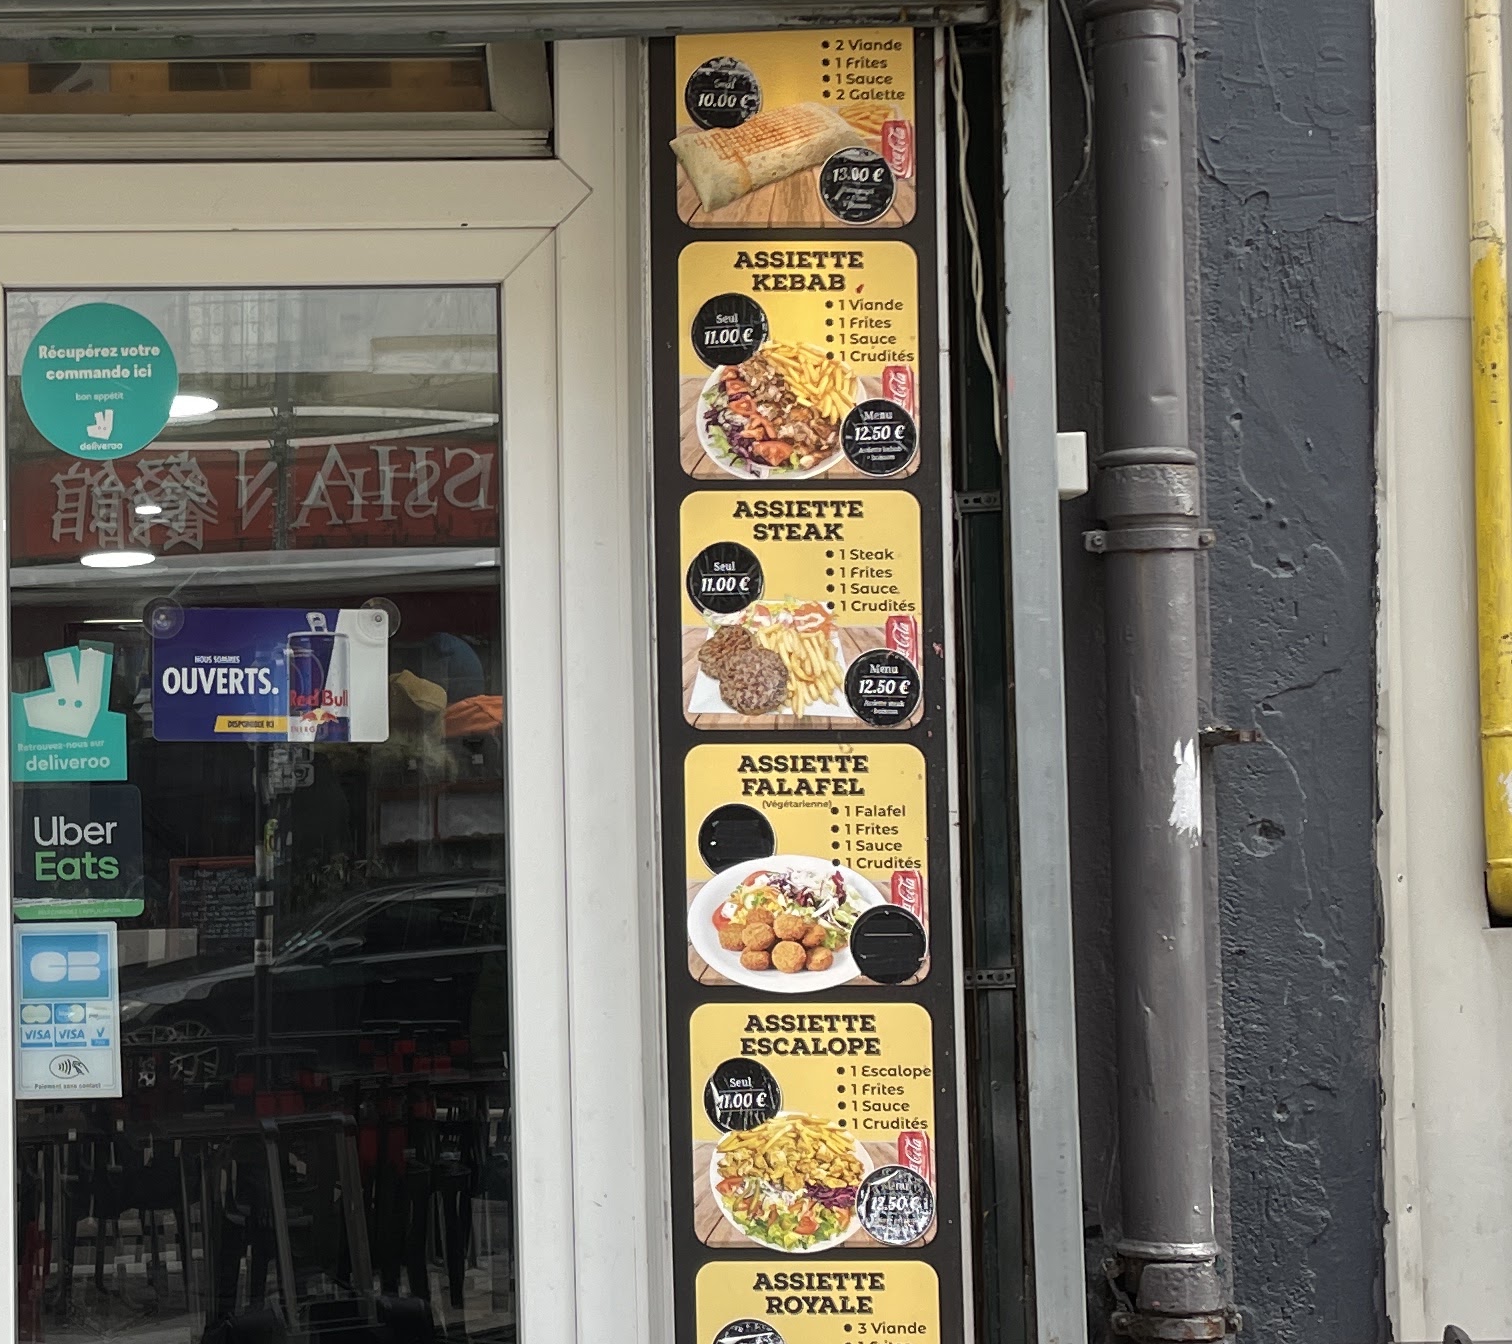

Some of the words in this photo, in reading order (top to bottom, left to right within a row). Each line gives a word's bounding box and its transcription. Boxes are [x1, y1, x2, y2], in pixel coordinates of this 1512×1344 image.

[835, 40, 844, 51] 2
[848, 39, 903, 51] Viande
[698, 93, 737, 108] 10.00
[836, 90, 846, 100] 2
[849, 88, 905, 101] Galette
[872, 167, 885, 182] €
[734, 250, 864, 270] ASSIETTE
[752, 273, 846, 292] KEBAB
[838, 300, 845, 311] 1
[848, 298, 904, 311] Viande
[716, 313, 738, 324] Seul
[704, 328, 740, 345] 11.00
[743, 327, 754, 343] €
[38, 344, 118, 362] Récupérez
[120, 344, 161, 357] votre
[840, 351, 846, 362] 1
[850, 349, 915, 362] Crudités
[46, 364, 130, 380] commande
[133, 363, 152, 378] ici
[854, 425, 891, 441] 12.50
[895, 425, 906, 439] €
[79, 442, 123, 451] deliveroo
[732, 500, 864, 520] ASSIETTE
[753, 523, 845, 542] STEAK
[840, 549, 846, 560] 1
[850, 548, 895, 561] Steak
[713, 561, 736, 572] Seul
[701, 577, 736, 592] 11.00
[739, 576, 750, 591] €
[841, 601, 846, 612] 1
[851, 599, 916, 612] Crudités
[869, 664, 899, 674] Menu
[162, 666, 279, 695] OUVERTS.
[859, 679, 896, 694] 12.50
[899, 680, 911, 694] €
[290, 690, 320, 707] Red
[322, 689, 348, 706] Bull
[26, 753, 110, 772] deliveroo
[737, 755, 869, 774] ASSIETTE
[741, 778, 865, 797] FALAFEL
[844, 806, 851, 817] 1
[855, 804, 906, 817] Falafel
[33, 816, 118, 846] Uber
[35, 851, 119, 881] Eats
[846, 857, 852, 869] 1
[856, 856, 922, 869] Crudités
[744, 1014, 876, 1034] ASSIETTE
[25, 1029, 51, 1040] VISA
[59, 1029, 85, 1040] VISA
[740, 1037, 881, 1056] ESCALOPE
[851, 1065, 856, 1076] 1
[861, 1065, 932, 1079] Escalope
[729, 1077, 752, 1087] Seul
[756, 1092, 768, 1108] €
[853, 1119, 858, 1129] 1
[862, 1117, 928, 1130] Crudités
[752, 1271, 885, 1291] ASSIETTE
[765, 1295, 873, 1315] ROYALE
[858, 1322, 867, 1334] 3
[871, 1321, 927, 1335] Viande
